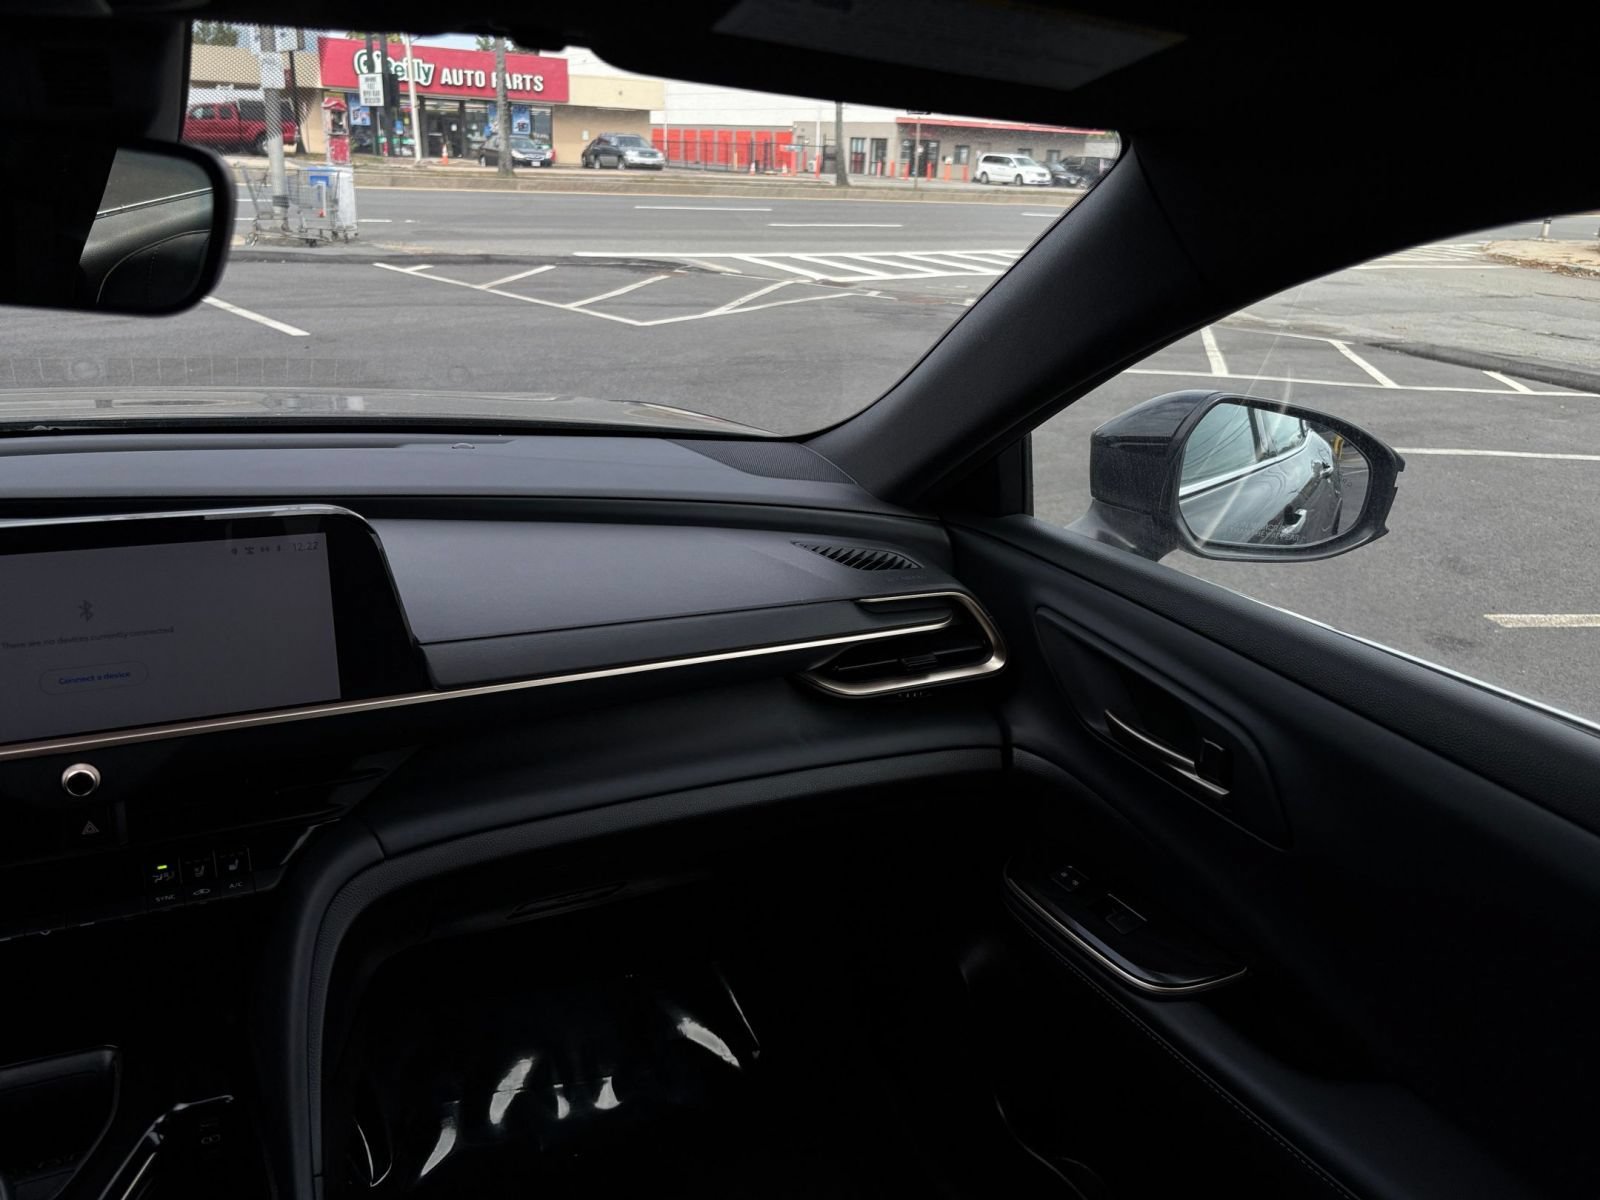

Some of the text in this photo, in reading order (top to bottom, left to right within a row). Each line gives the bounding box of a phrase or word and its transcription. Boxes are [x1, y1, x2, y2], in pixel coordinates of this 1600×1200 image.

[440, 67, 486, 88] AUTO
[1, 641, 25, 649] There
[57, 636, 88, 645] devices
[90, 631, 127, 642] currently
[129, 626, 174, 637] connected
[58, 675, 95, 685] Connect
[103, 671, 131, 681] device
[154, 894, 176, 903] SYNC
